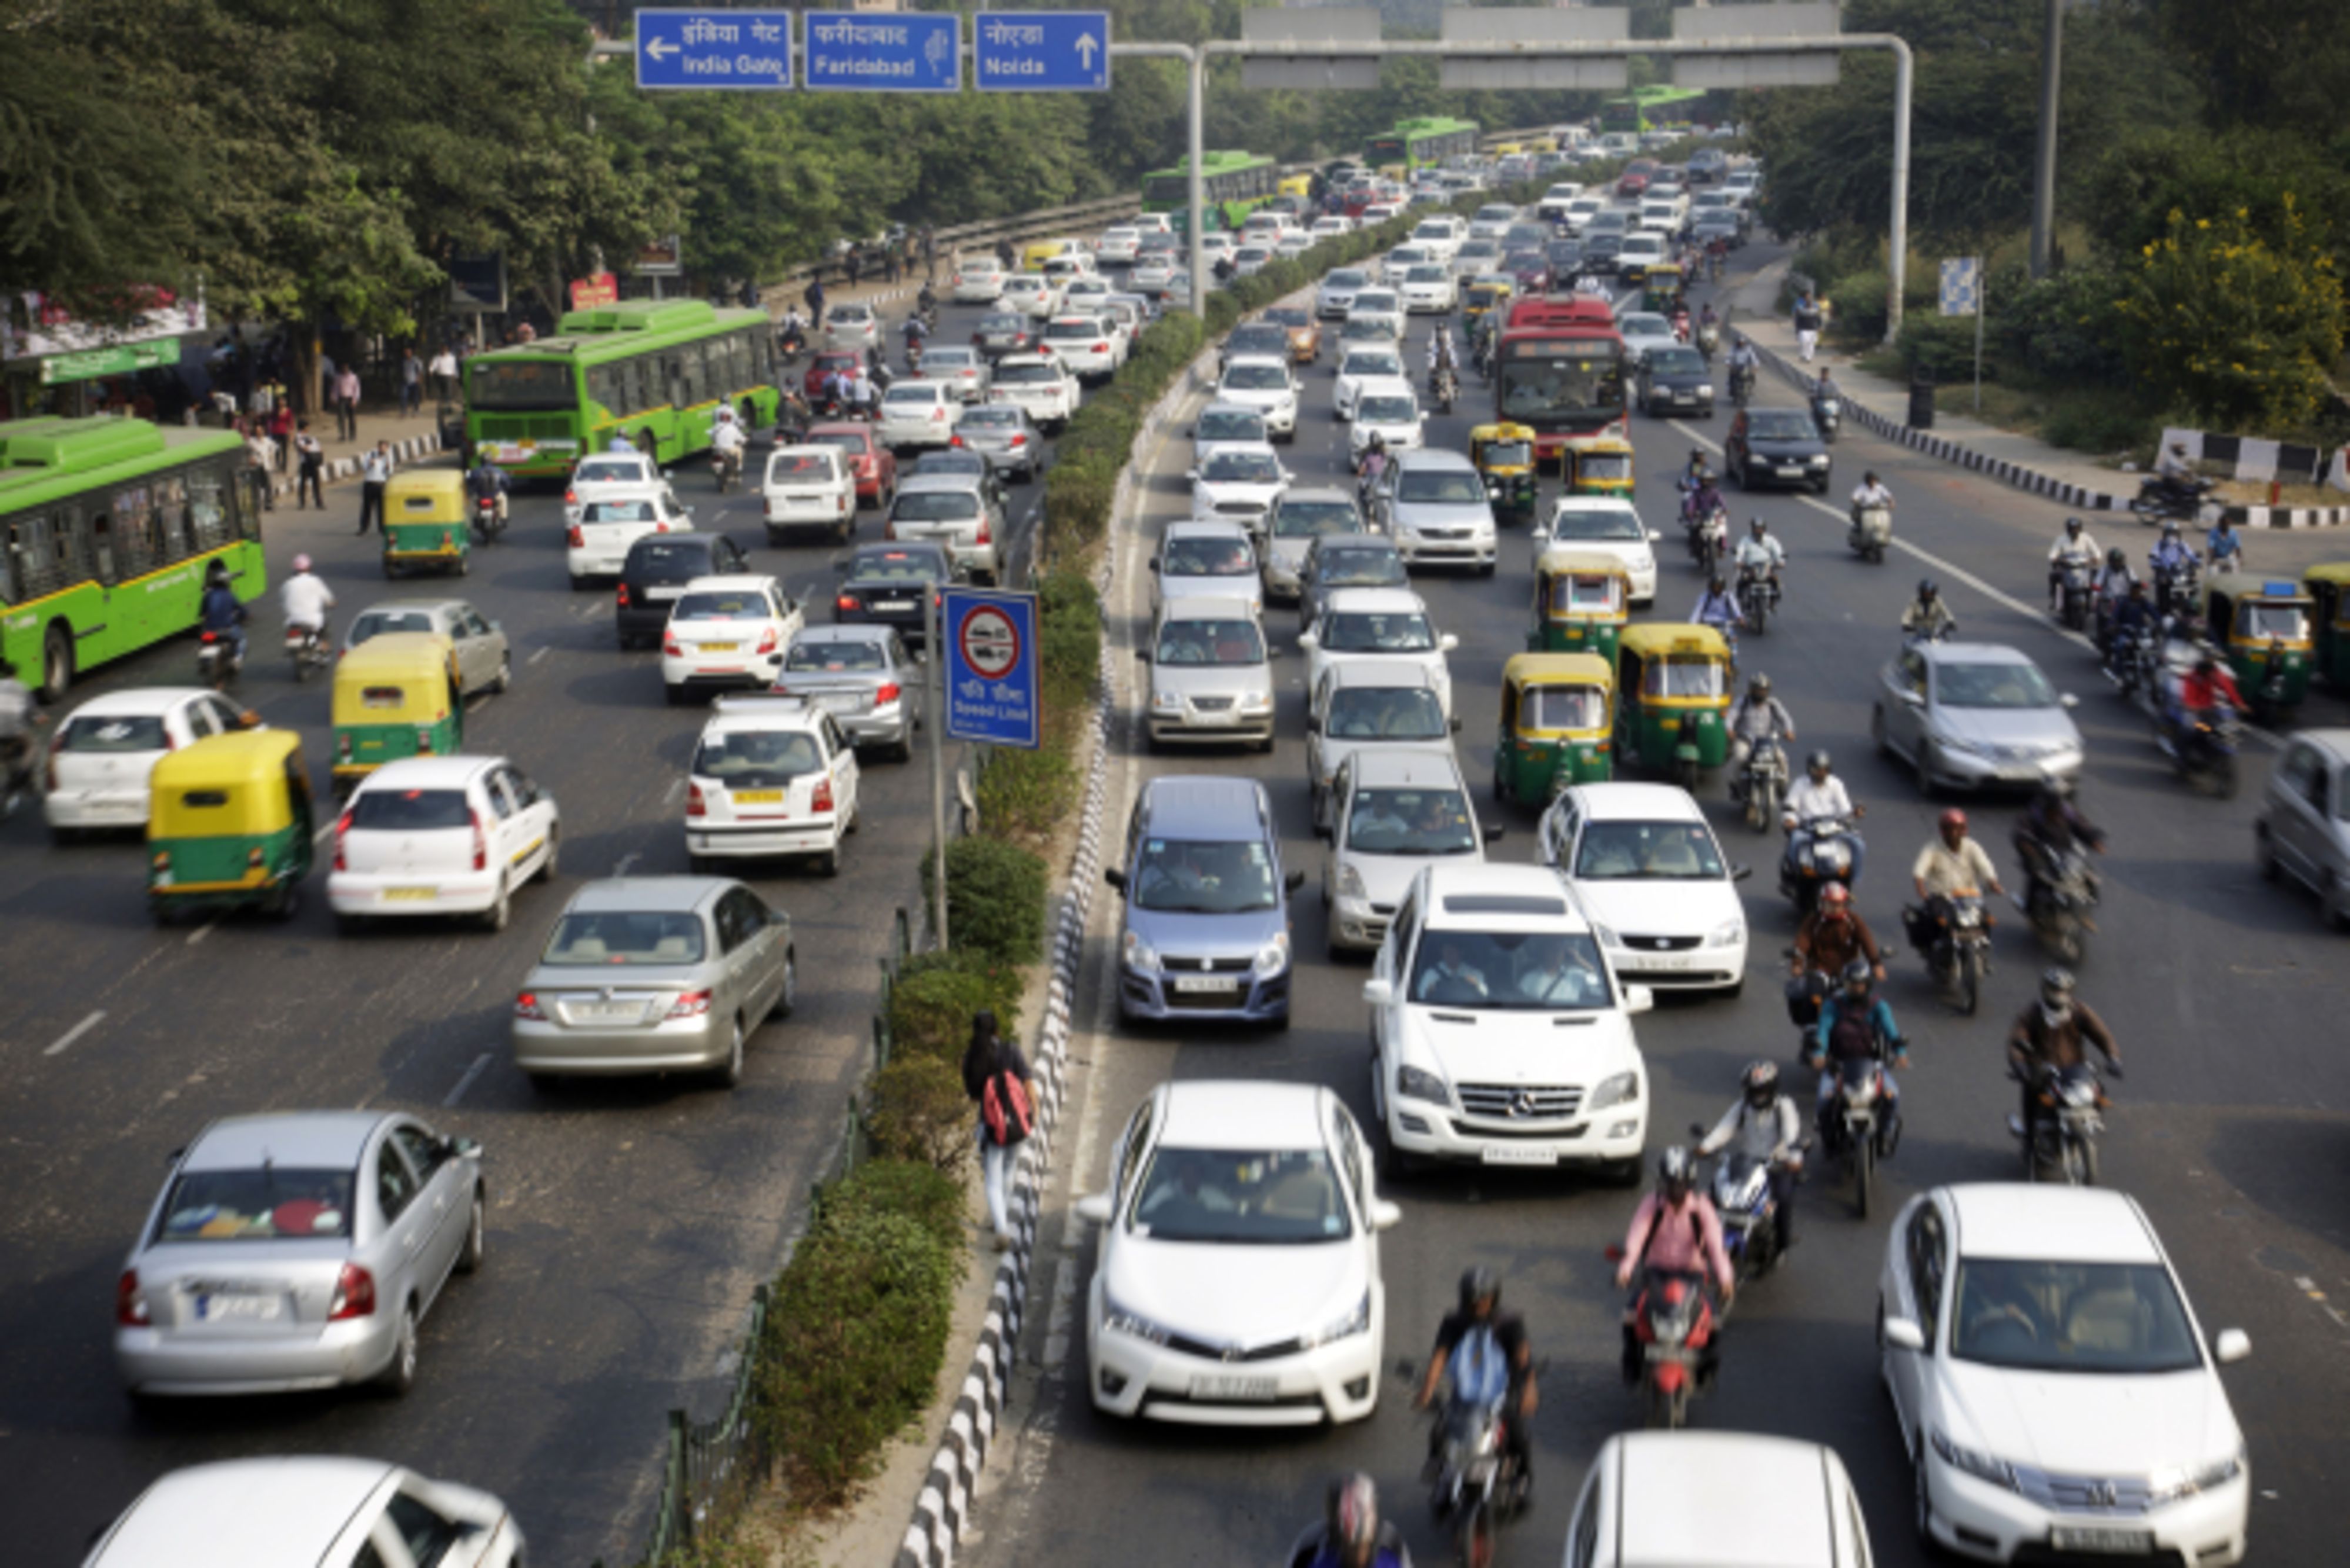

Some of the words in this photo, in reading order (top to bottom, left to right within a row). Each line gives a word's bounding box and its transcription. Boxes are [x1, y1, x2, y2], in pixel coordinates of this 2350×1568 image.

[750, 18, 781, 44] गेट
[814, 18, 908, 46] फरीदाबाद
[984, 19, 1044, 48] नोएडा
[683, 56, 731, 74] India
[737, 56, 783, 75] Gate
[815, 55, 915, 75] Faridabad
[985, 57, 1045, 75] Noida
